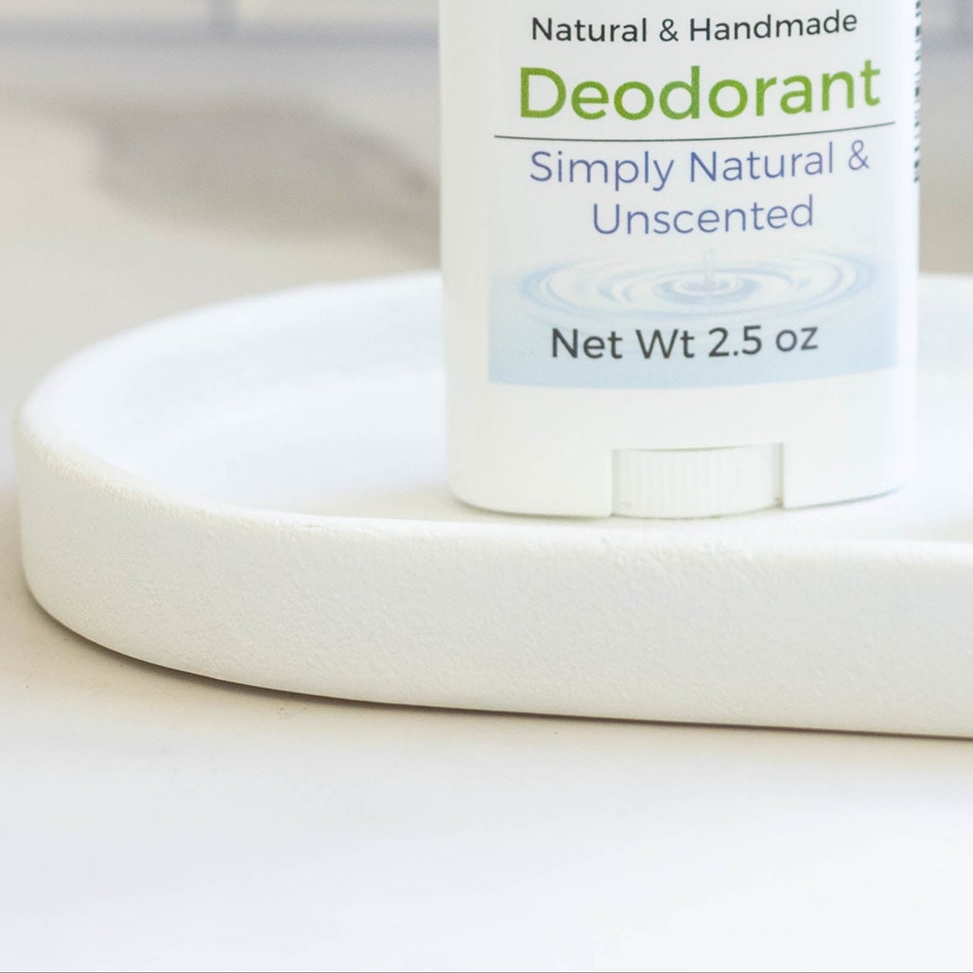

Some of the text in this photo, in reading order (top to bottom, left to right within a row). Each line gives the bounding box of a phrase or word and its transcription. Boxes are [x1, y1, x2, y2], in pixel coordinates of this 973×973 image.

[531, 10, 857, 42] Natural & Handmade
[519, 60, 881, 120] Deodorant
[530, 140, 870, 191] Simply Natural &
[593, 195, 814, 234] Unscented
[551, 325, 818, 359] Net Wt 2.5 oz
